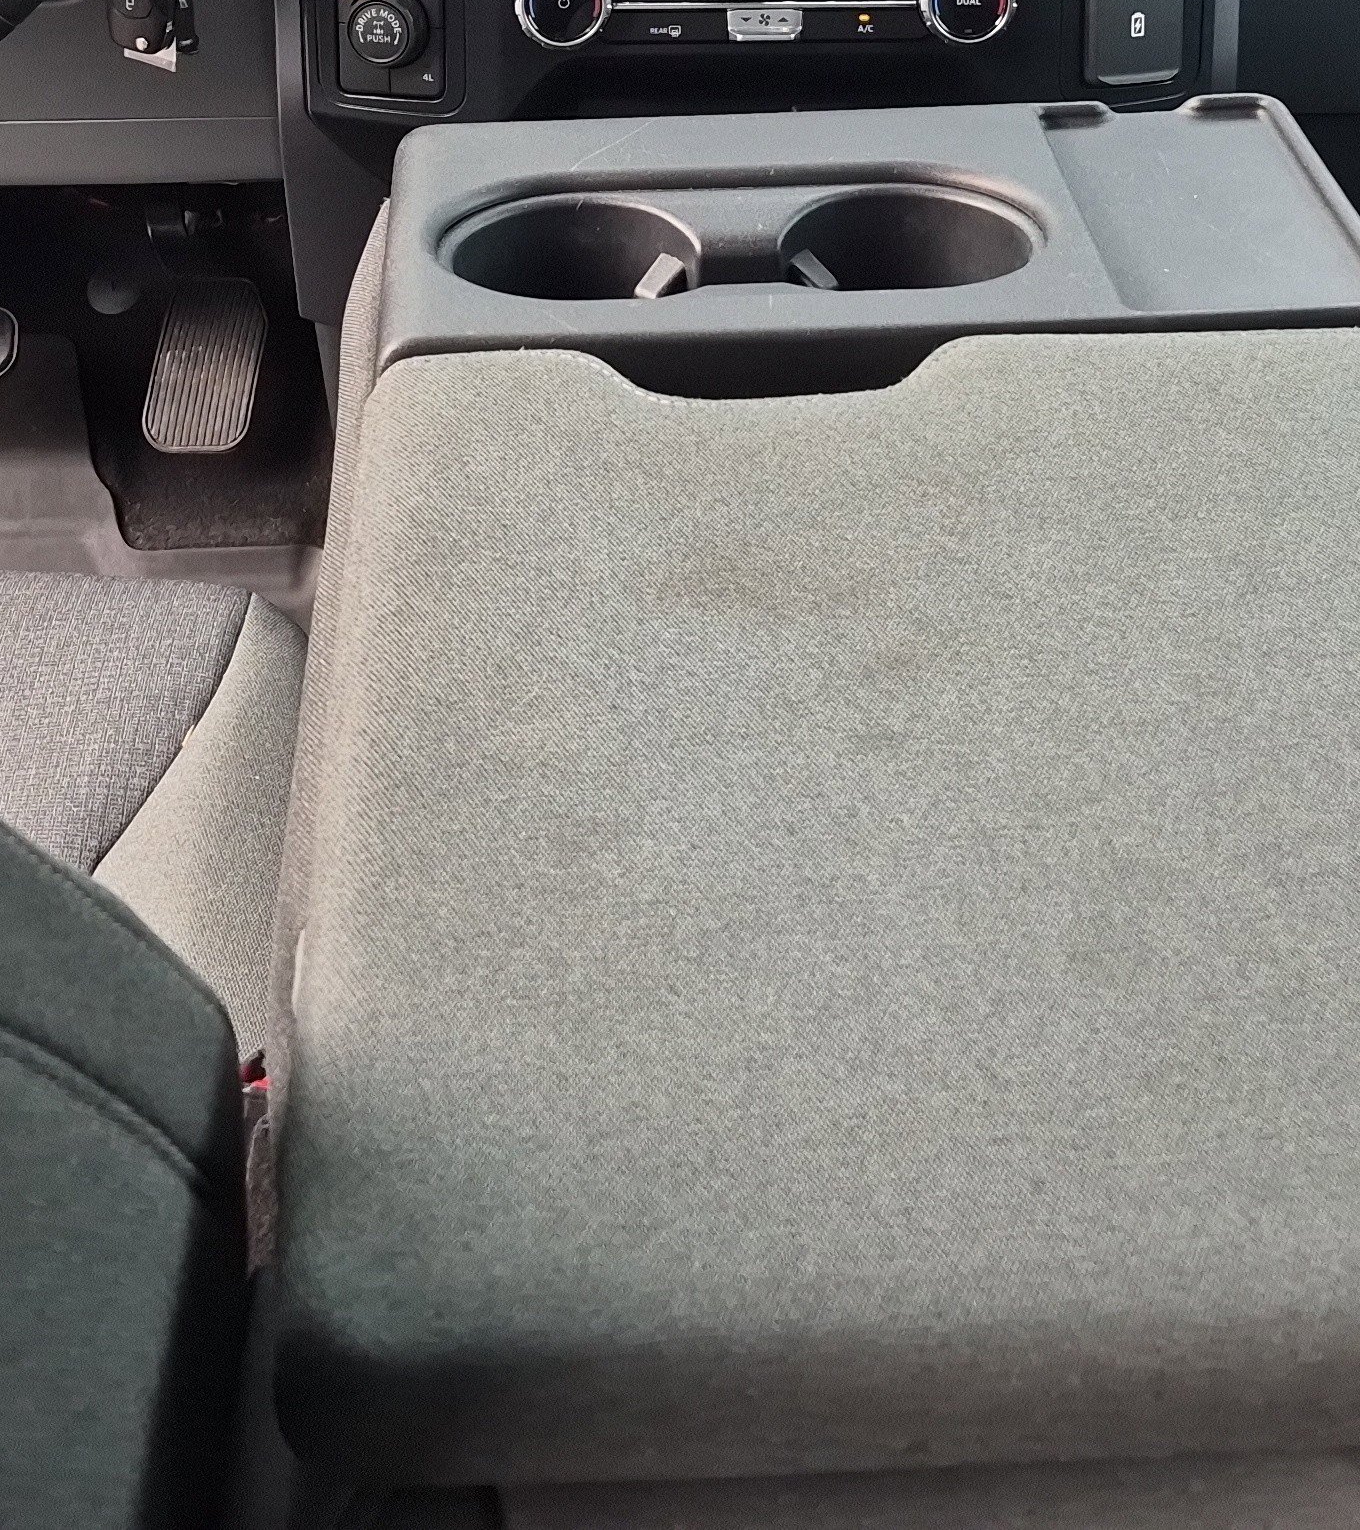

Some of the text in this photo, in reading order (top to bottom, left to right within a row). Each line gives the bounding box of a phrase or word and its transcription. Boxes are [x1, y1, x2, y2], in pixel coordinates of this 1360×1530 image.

[355, 8, 403, 34] DRIVE MODE
[857, 25, 874, 33] A/C
[366, 33, 391, 44] PUSH
[422, 72, 434, 82] 4L
